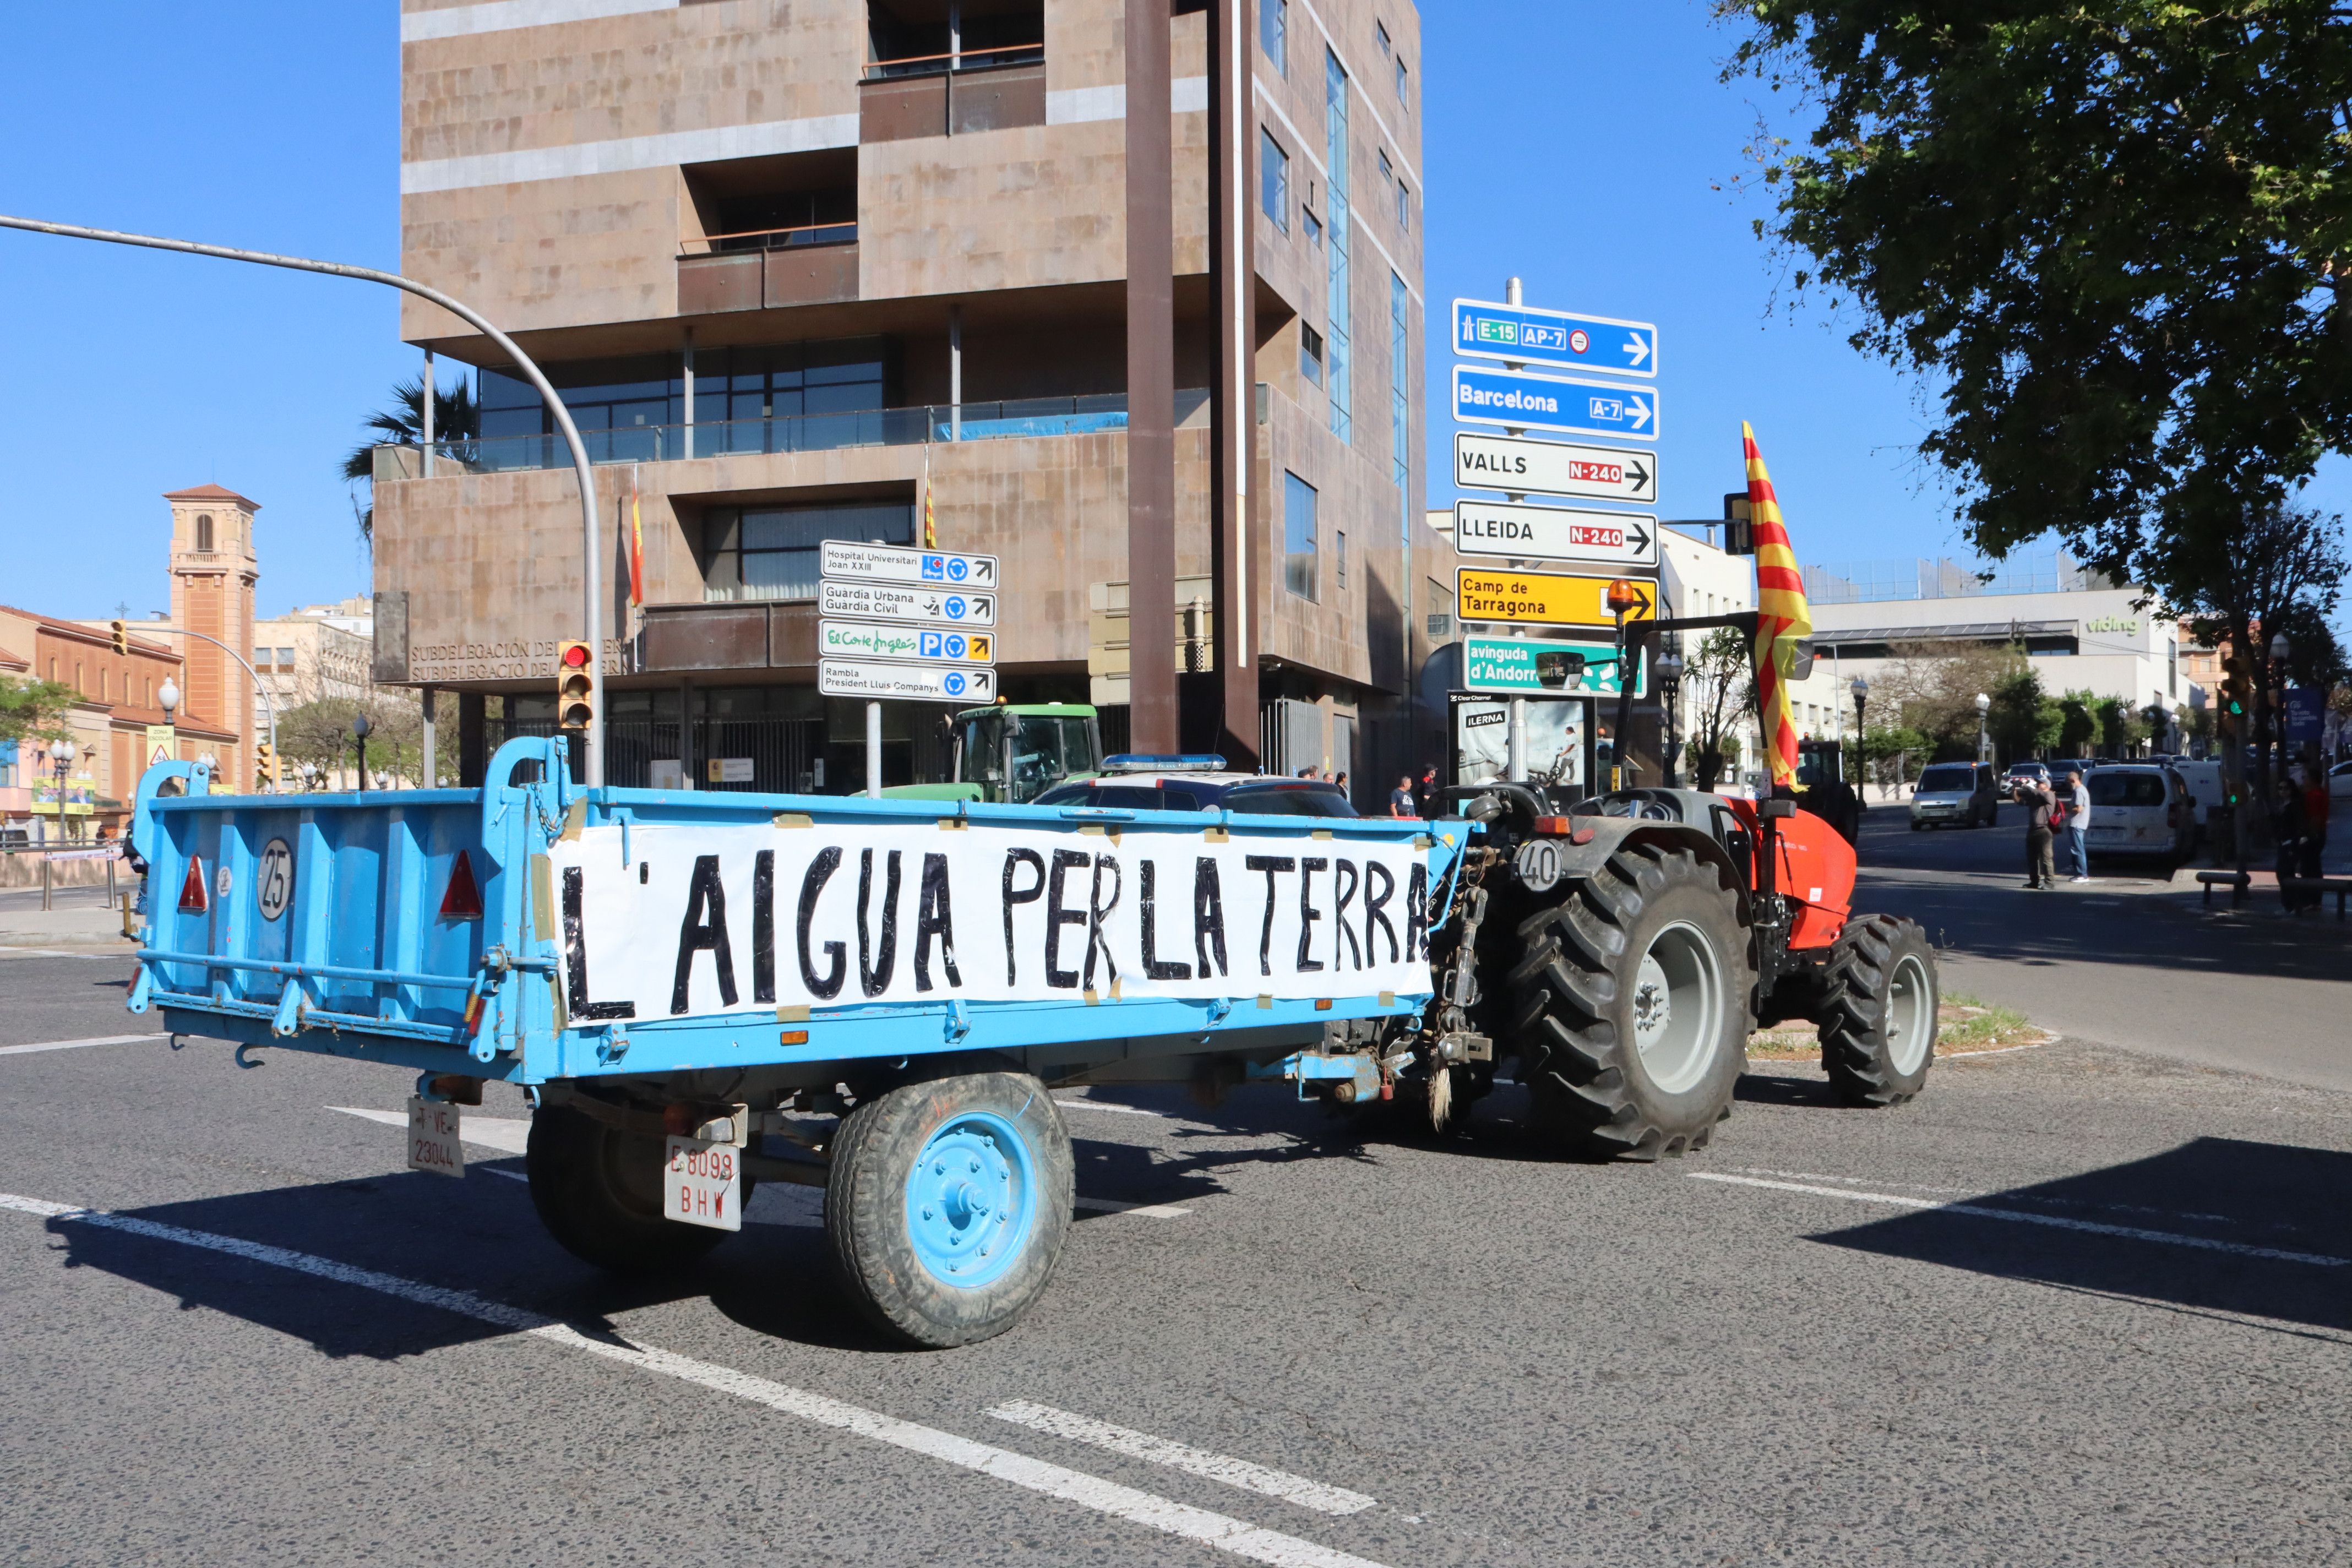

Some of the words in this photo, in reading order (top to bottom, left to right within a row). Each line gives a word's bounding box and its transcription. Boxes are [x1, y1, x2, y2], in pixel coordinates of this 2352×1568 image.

[1480, 323, 1515, 340] E-15
[1525, 328, 1563, 346] AP-7
[1460, 384, 1558, 412] Barcelona
[1593, 401, 1620, 417] A-7
[1462, 451, 1527, 474] VALLS
[1570, 463, 1620, 481] N-240
[1463, 519, 1533, 540] LLEIDA
[1571, 527, 1622, 545] N-240
[827, 551, 864, 561] Hospital
[868, 553, 917, 565] Universitari
[828, 560, 848, 569] Joan
[851, 562, 872, 571] XXIII
[826, 586, 869, 600] Guàrdia
[874, 590, 914, 603] Urbana
[1463, 579, 1504, 595] Camp
[1511, 582, 1528, 594] de
[826, 599, 869, 611] Guàrdia
[874, 602, 898, 614] Civil
[1464, 595, 1546, 616] Tarragona
[828, 630, 840, 644] El
[842, 631, 872, 646] Corte
[873, 630, 916, 654] Inglés
[1471, 645, 1528, 663] avinguda
[531, 662, 556, 677] DEL
[826, 668, 859, 677] Rambla
[1471, 661, 1539, 682] d'Andorr
[826, 678, 867, 688] President
[894, 682, 939, 693] Companys
[1468, 714, 1503, 726] ILERNA
[1526, 846, 1555, 884] 40
[263, 848, 287, 909] 25
[562, 845, 962, 1022] L'AIGUA
[1001, 847, 1121, 991] PER
[1140, 856, 1228, 981] LA
[1244, 854, 1430, 977] TERRA
[415, 1140, 454, 1168] 23044
[688, 1148, 732, 1181] 8098
